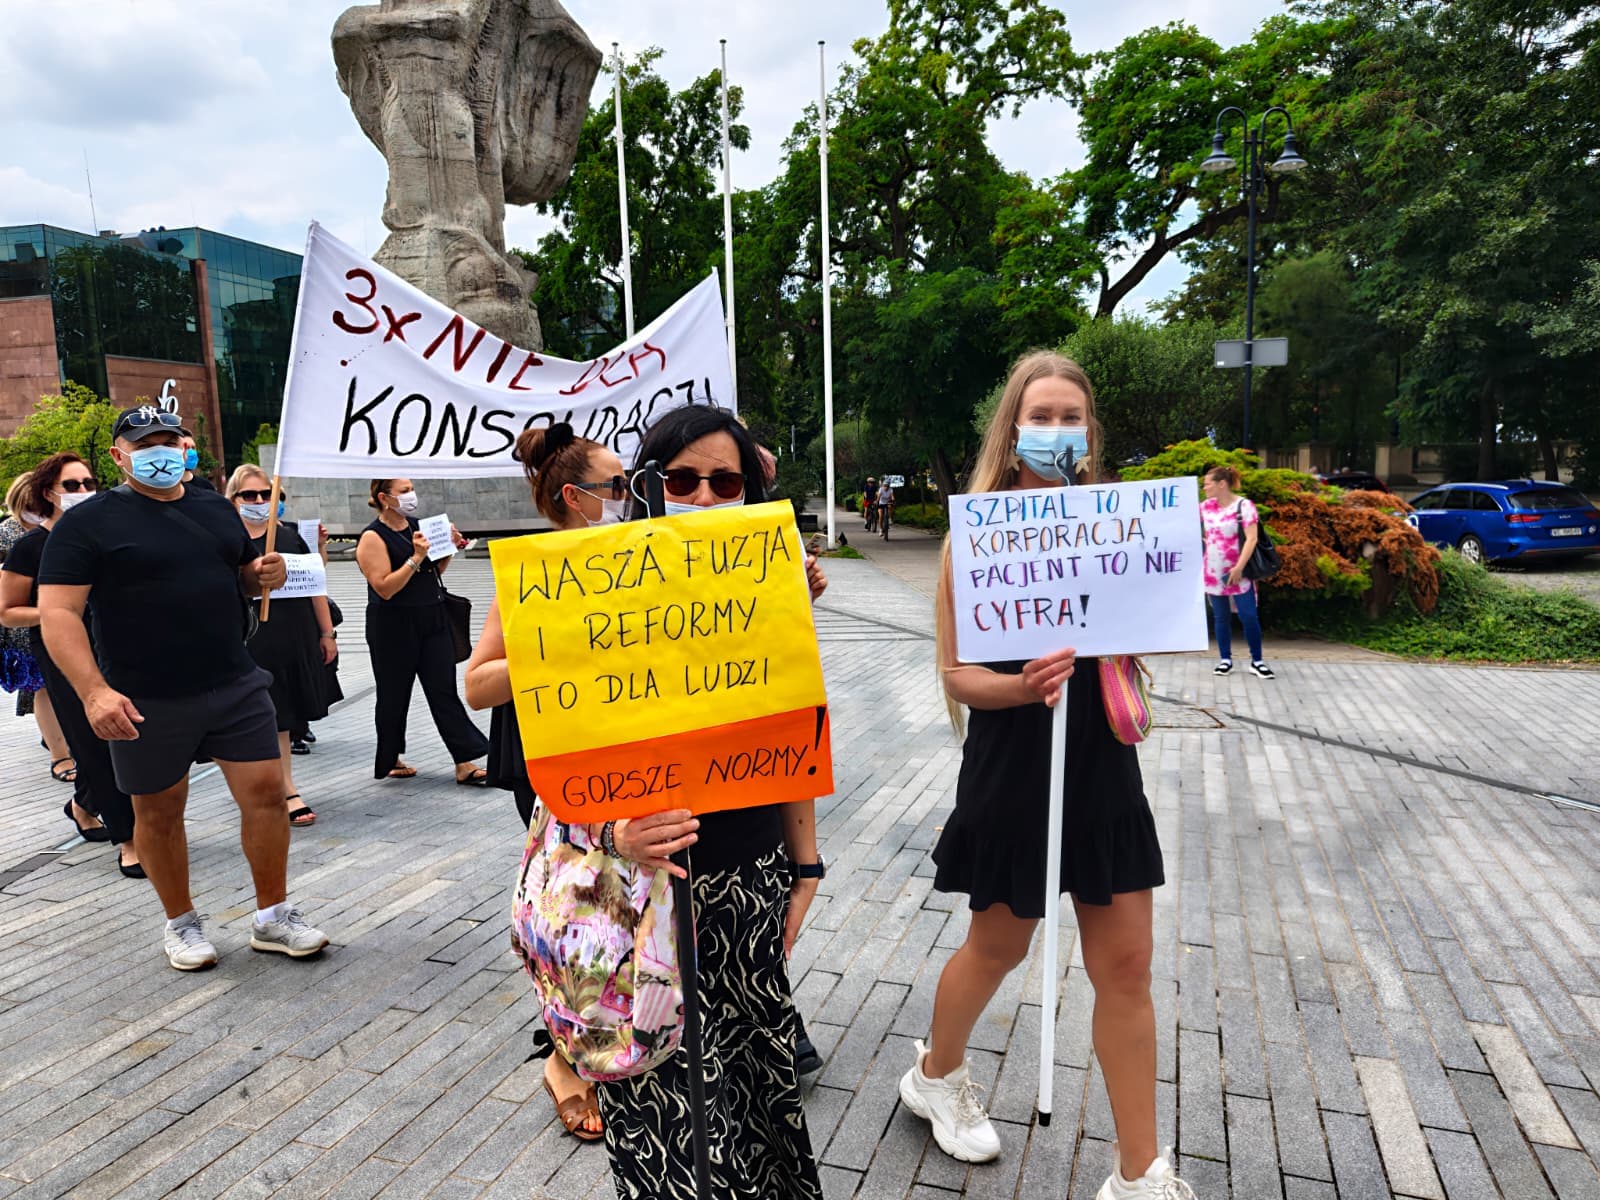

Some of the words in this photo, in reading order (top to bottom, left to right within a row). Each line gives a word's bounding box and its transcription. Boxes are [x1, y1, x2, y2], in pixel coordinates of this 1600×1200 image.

[965, 492, 1078, 527] SZPITAL
[1090, 489, 1120, 515] TO
[1142, 485, 1180, 513] NIE
[969, 517, 1159, 557] KORPORACJA,
[519, 545, 666, 604] WASZA
[682, 526, 791, 584] FUZJA
[969, 556, 1082, 589] PACJENT
[1094, 551, 1129, 576] TO
[1145, 551, 1183, 574] NIE
[538, 626, 545, 661] I
[584, 597, 758, 651] REFORMY
[973, 594, 1090, 633] CYFRA!
[520, 681, 578, 714] TO
[595, 668, 661, 704] DLA
[685, 657, 769, 696] LUDZI
[562, 763, 682, 807] GORSZE
[705, 706, 826, 784] NORMY!
